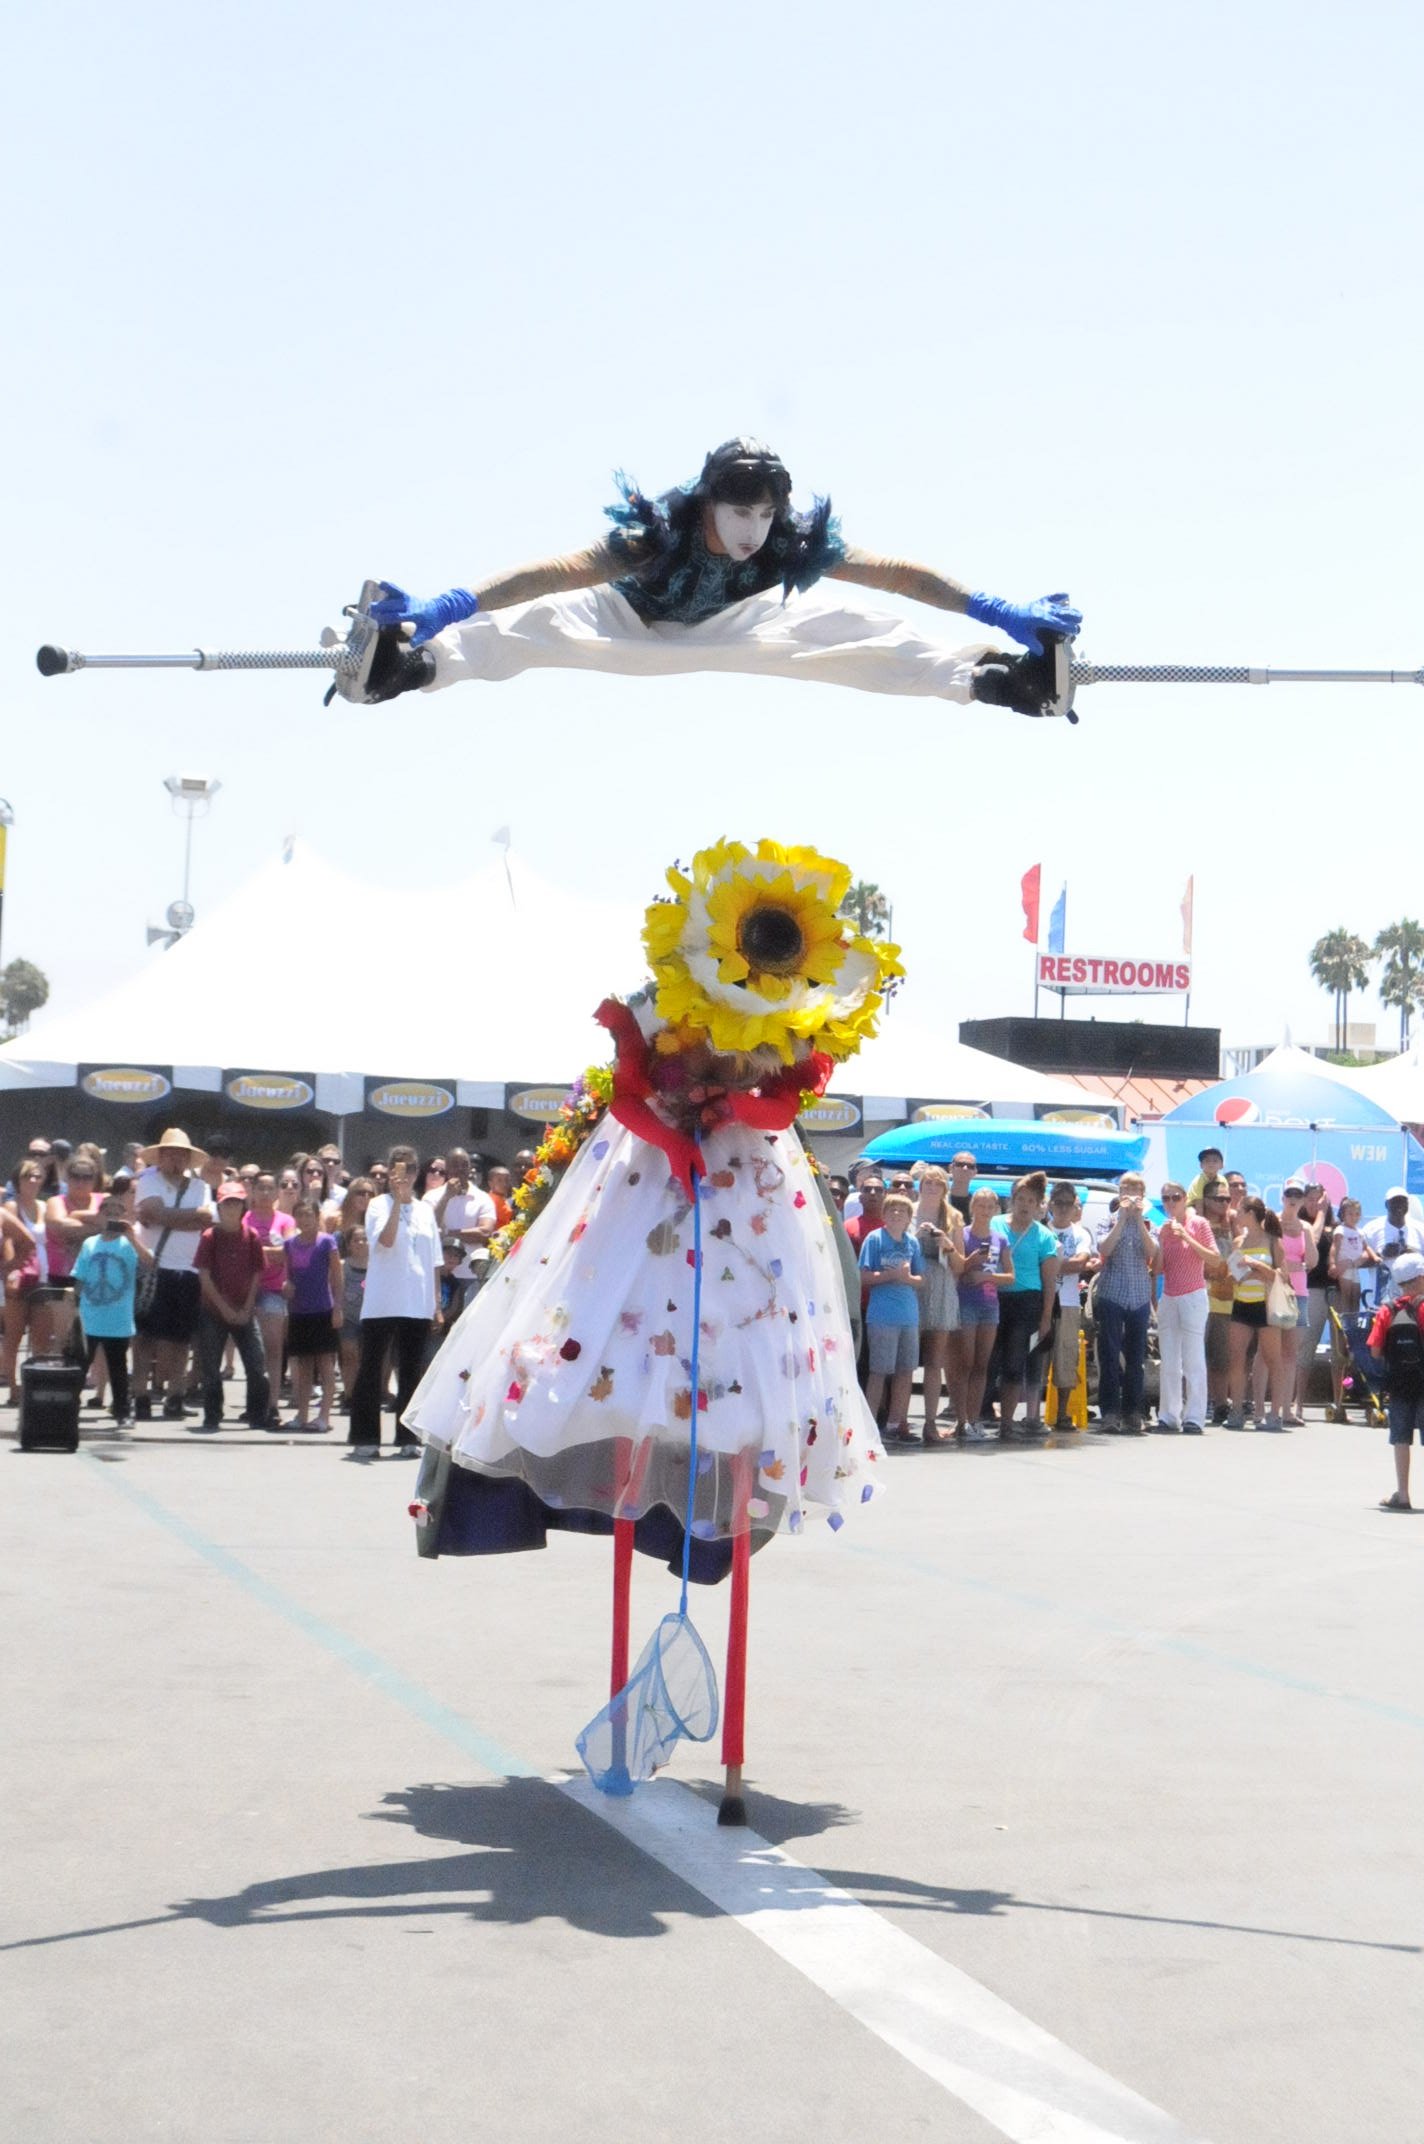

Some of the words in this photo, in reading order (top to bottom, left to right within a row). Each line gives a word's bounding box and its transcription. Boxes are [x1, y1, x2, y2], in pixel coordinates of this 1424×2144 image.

[1040, 956, 1190, 989] RESTROOMS
[92, 1077, 159, 1092] Jacuzzi
[236, 1082, 300, 1099] Jacuzzi
[379, 1091, 442, 1106] Jacuzzi
[519, 1096, 562, 1111] Jacu
